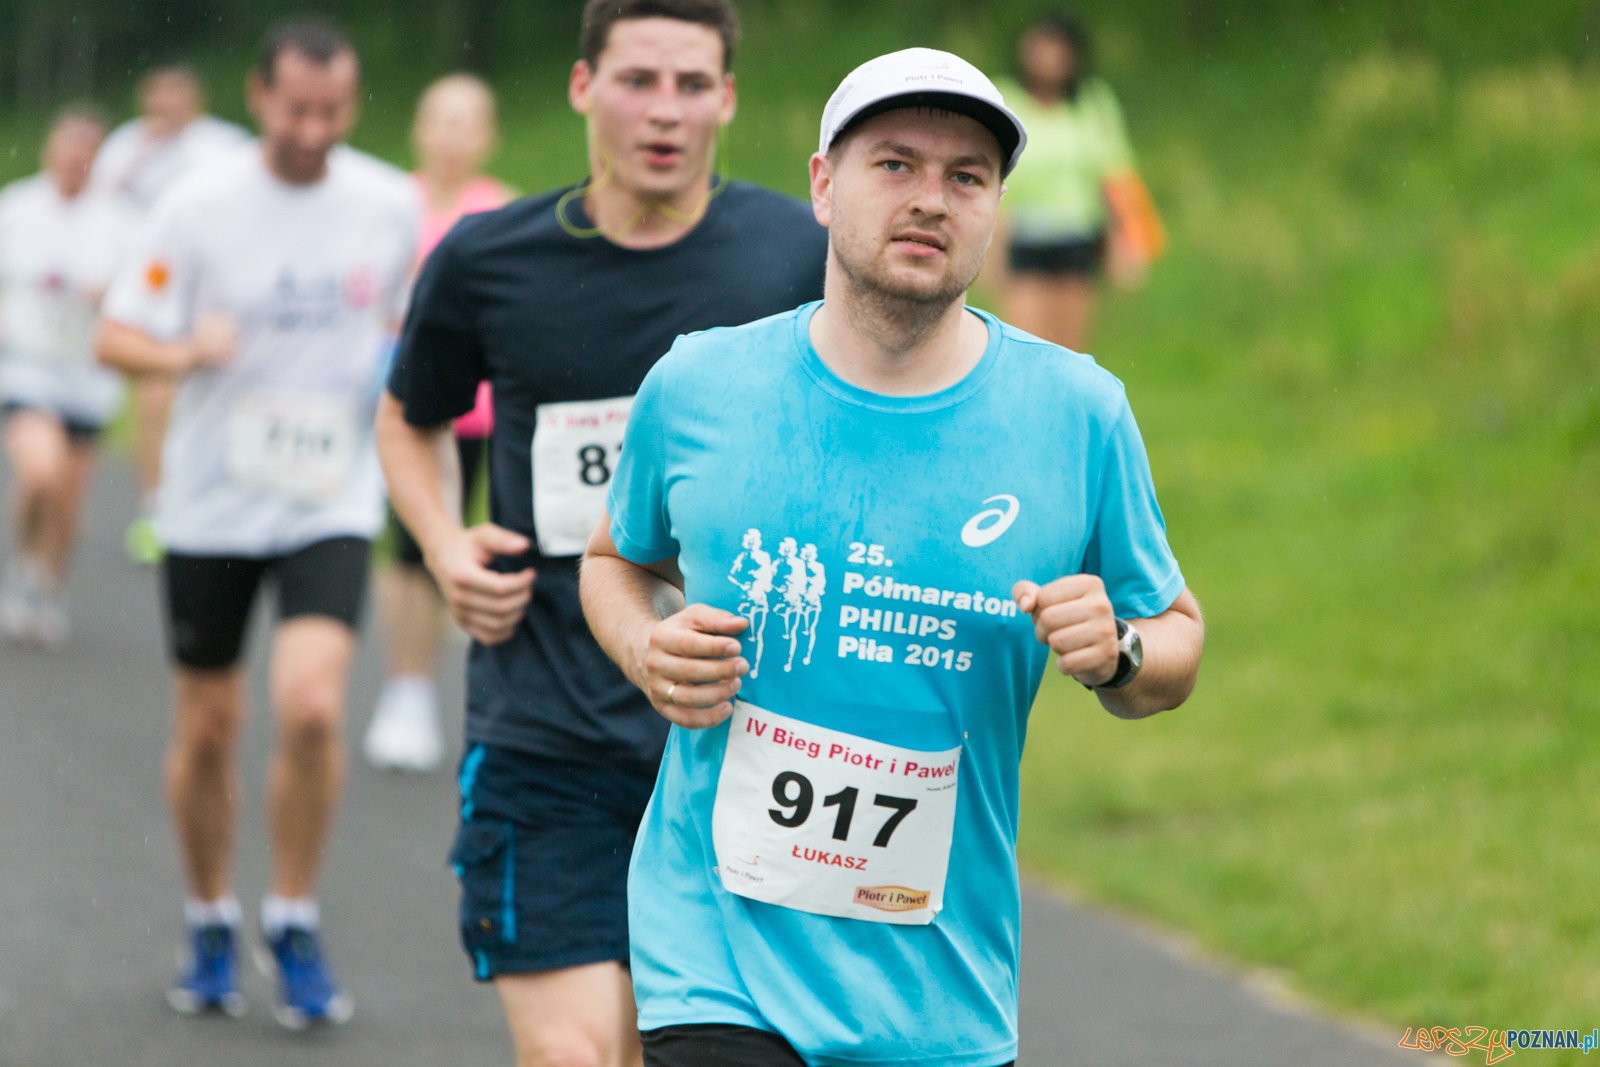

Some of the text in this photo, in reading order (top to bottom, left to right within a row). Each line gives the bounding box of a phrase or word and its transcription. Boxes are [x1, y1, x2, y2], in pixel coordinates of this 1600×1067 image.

[847, 542, 894, 567] 25.
[843, 571, 1018, 618] Półmaraton
[839, 605, 957, 641] PHILIPS
[838, 635, 974, 672] Piła 2015
[746, 717, 767, 737] IV
[772, 727, 821, 758] Bieg
[828, 743, 883, 771] Piotr
[889, 759, 897, 774] i
[768, 770, 918, 848] 917
[791, 845, 868, 871] ŁUKASZ
[857, 889, 886, 902] Piotr
